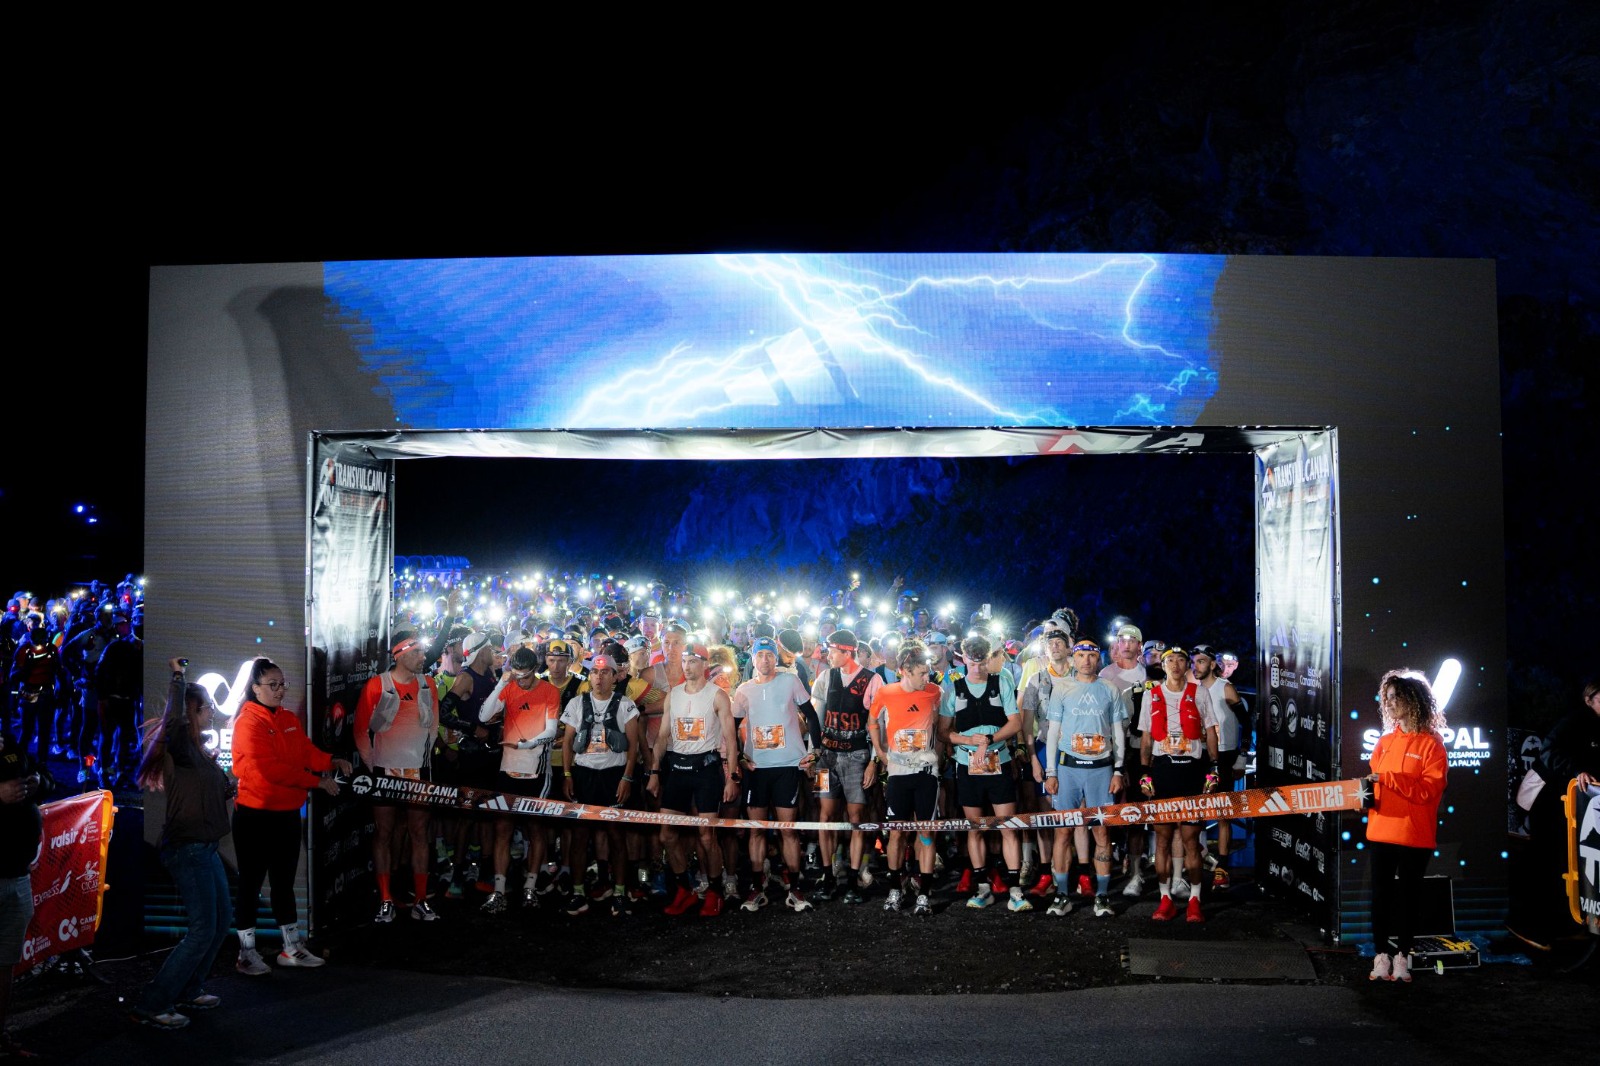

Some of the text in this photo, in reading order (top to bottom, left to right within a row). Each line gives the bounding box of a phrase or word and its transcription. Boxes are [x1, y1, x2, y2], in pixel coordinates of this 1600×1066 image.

[683, 724, 694, 733] 27
[1362, 727, 1489, 751] SPAL
[1448, 752, 1490, 760] DESARROLLO
[1448, 759, 1480, 768] LA PALMA
[376, 777, 458, 798] TRANSVULCANIA
[1143, 795, 1232, 815] TRANSVULCANIA
[624, 811, 709, 824] TRANSVULCANIA
[881, 819, 970, 829] TRANSVULCANIA
[51, 828, 78, 850] valsir
